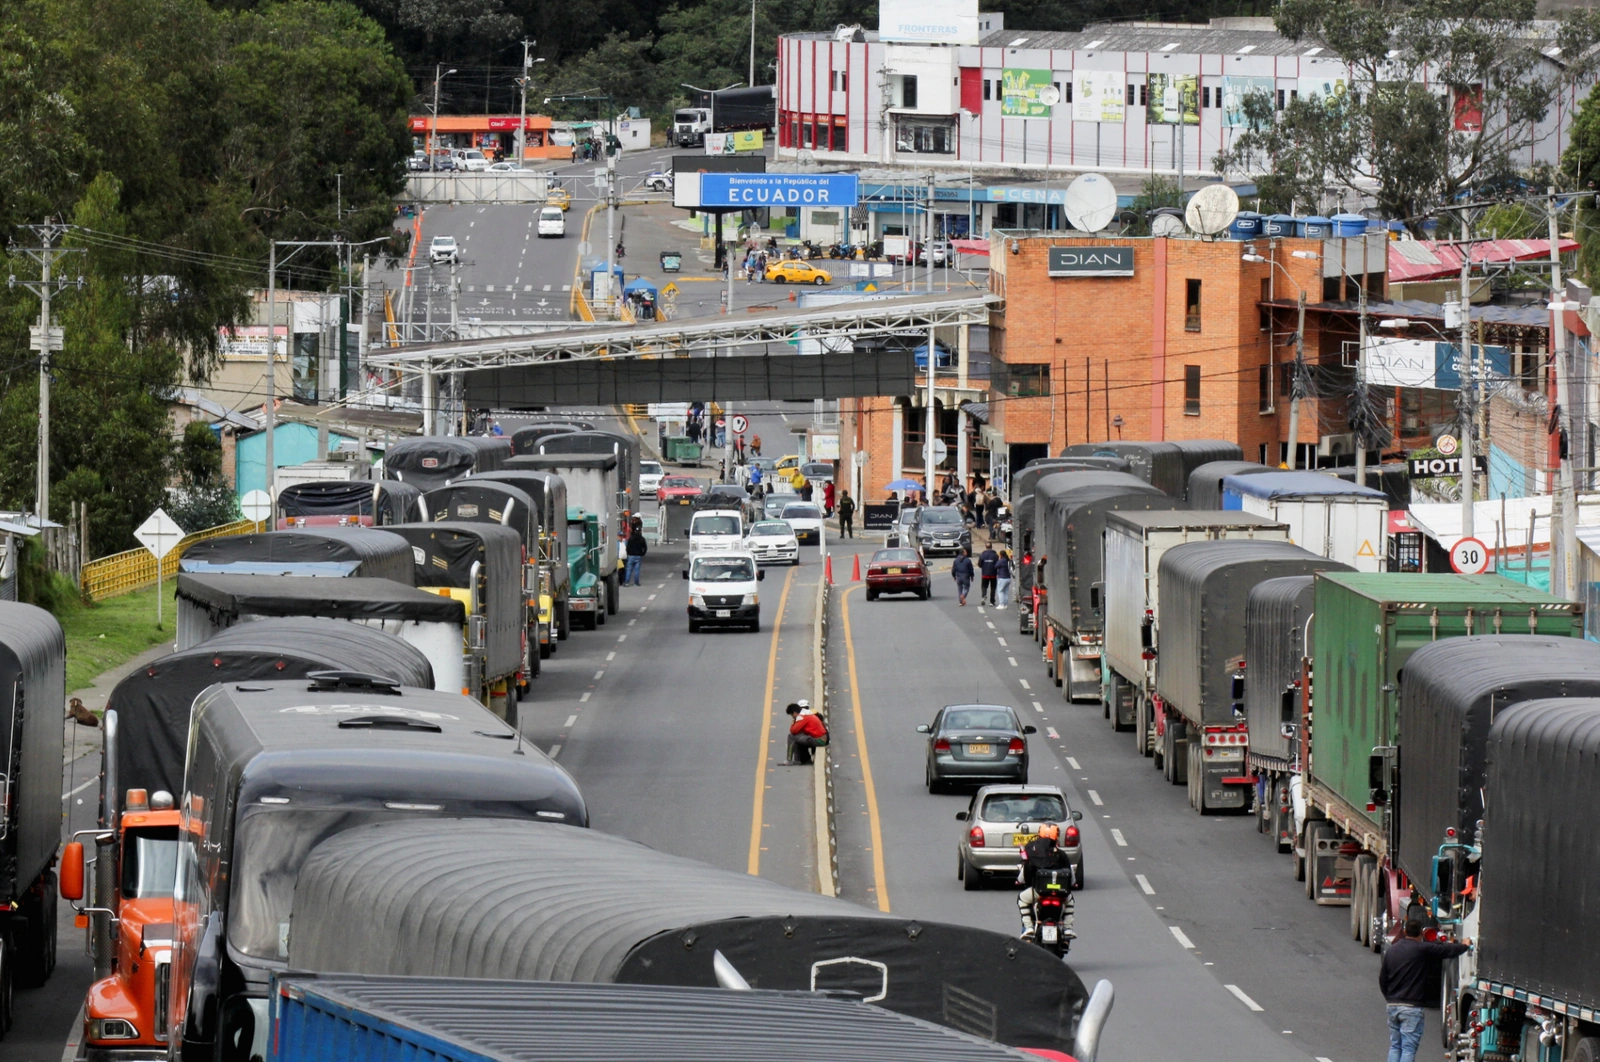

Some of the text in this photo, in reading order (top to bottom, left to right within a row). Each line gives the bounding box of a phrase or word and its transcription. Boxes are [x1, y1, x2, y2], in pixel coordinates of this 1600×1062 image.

[899, 24, 958, 34] FRONTERAS
[729, 177, 768, 185] Bienvenido
[775, 177, 781, 185] la
[783, 177, 818, 186] República
[728, 188, 830, 203] ECUADOR
[1060, 253, 1121, 265] DIAN
[1371, 355, 1424, 370] DIAN
[1461, 550, 1479, 565] 30
